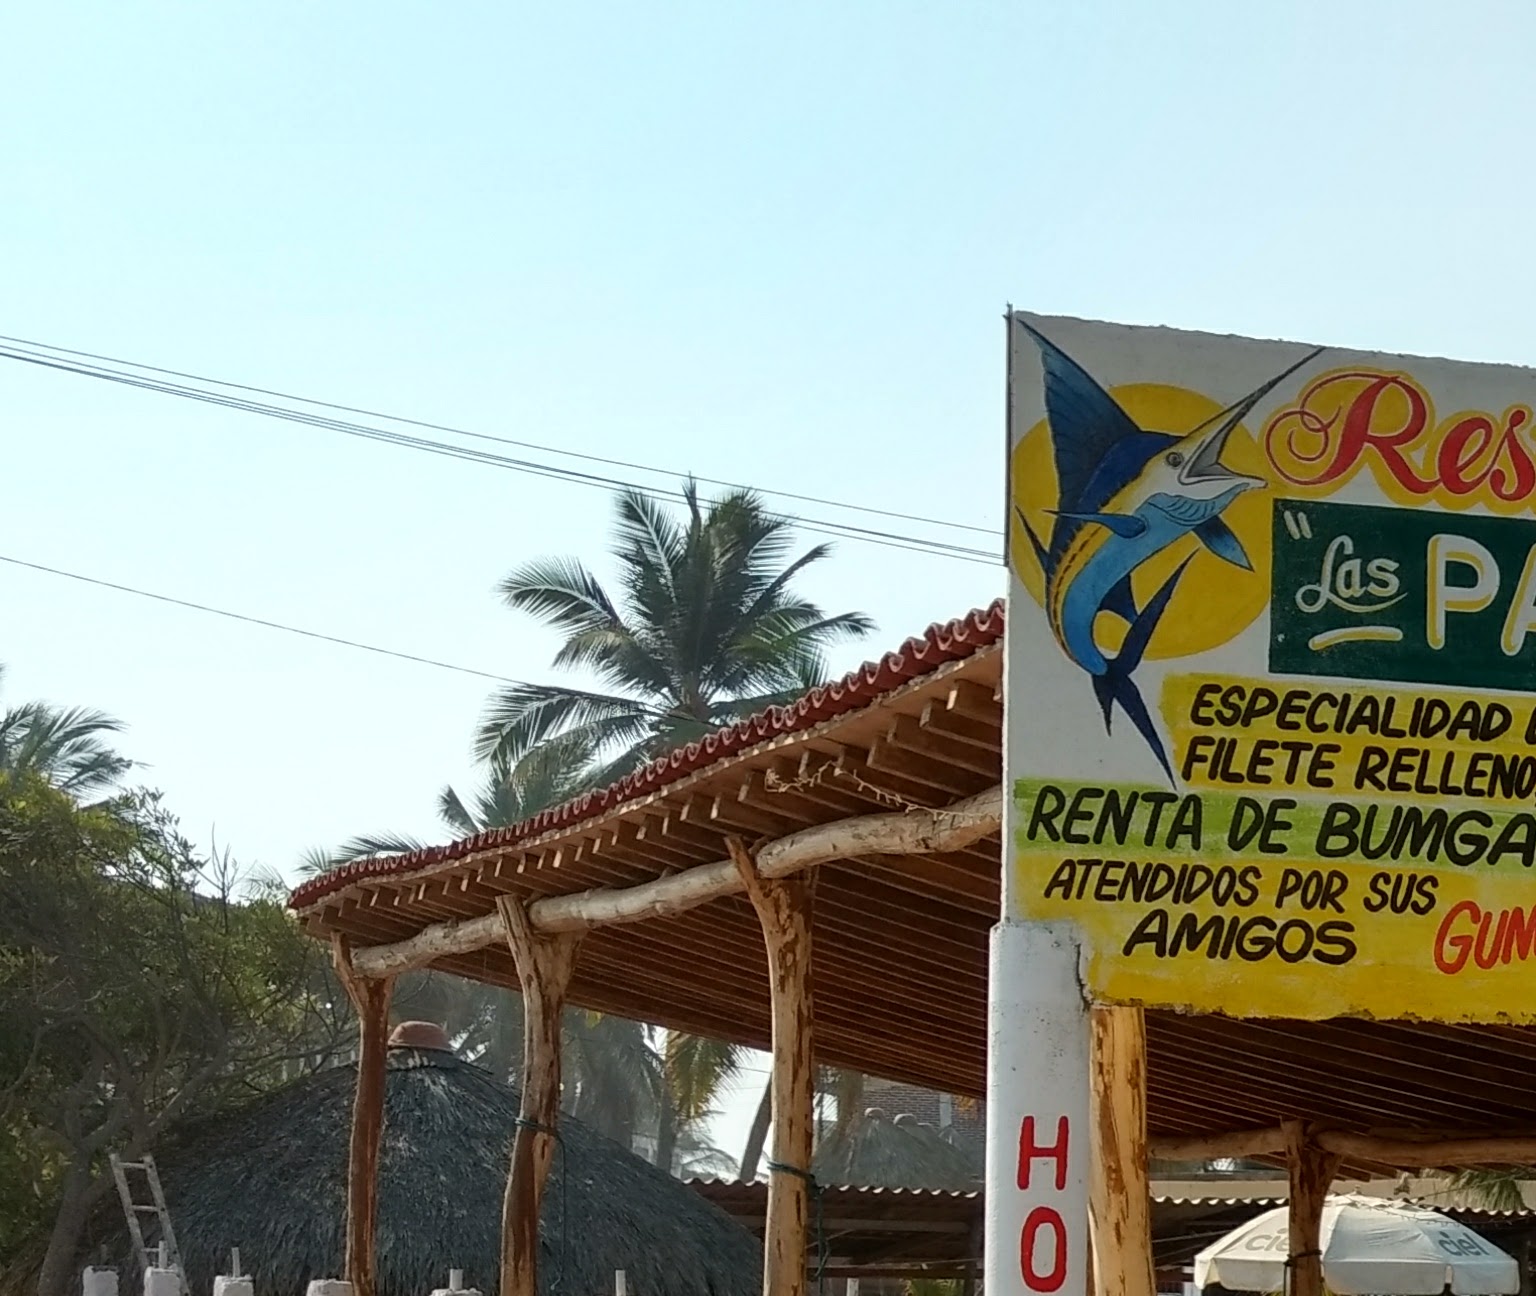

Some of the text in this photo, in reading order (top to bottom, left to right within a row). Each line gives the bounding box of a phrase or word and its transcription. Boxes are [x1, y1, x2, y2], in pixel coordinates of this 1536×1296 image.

[1189, 683, 1513, 742] ESPECIALIDAD
[1181, 735, 1342, 787] FILETE
[1026, 785, 1201, 852] RENTA
[1227, 796, 1298, 855] DE
[1043, 858, 1440, 916] ATENDIDOS POR SUS
[1122, 908, 1358, 966] AMIGOS
[1245, 1227, 1290, 1252] cie
[1437, 1230, 1491, 1257] ciel
